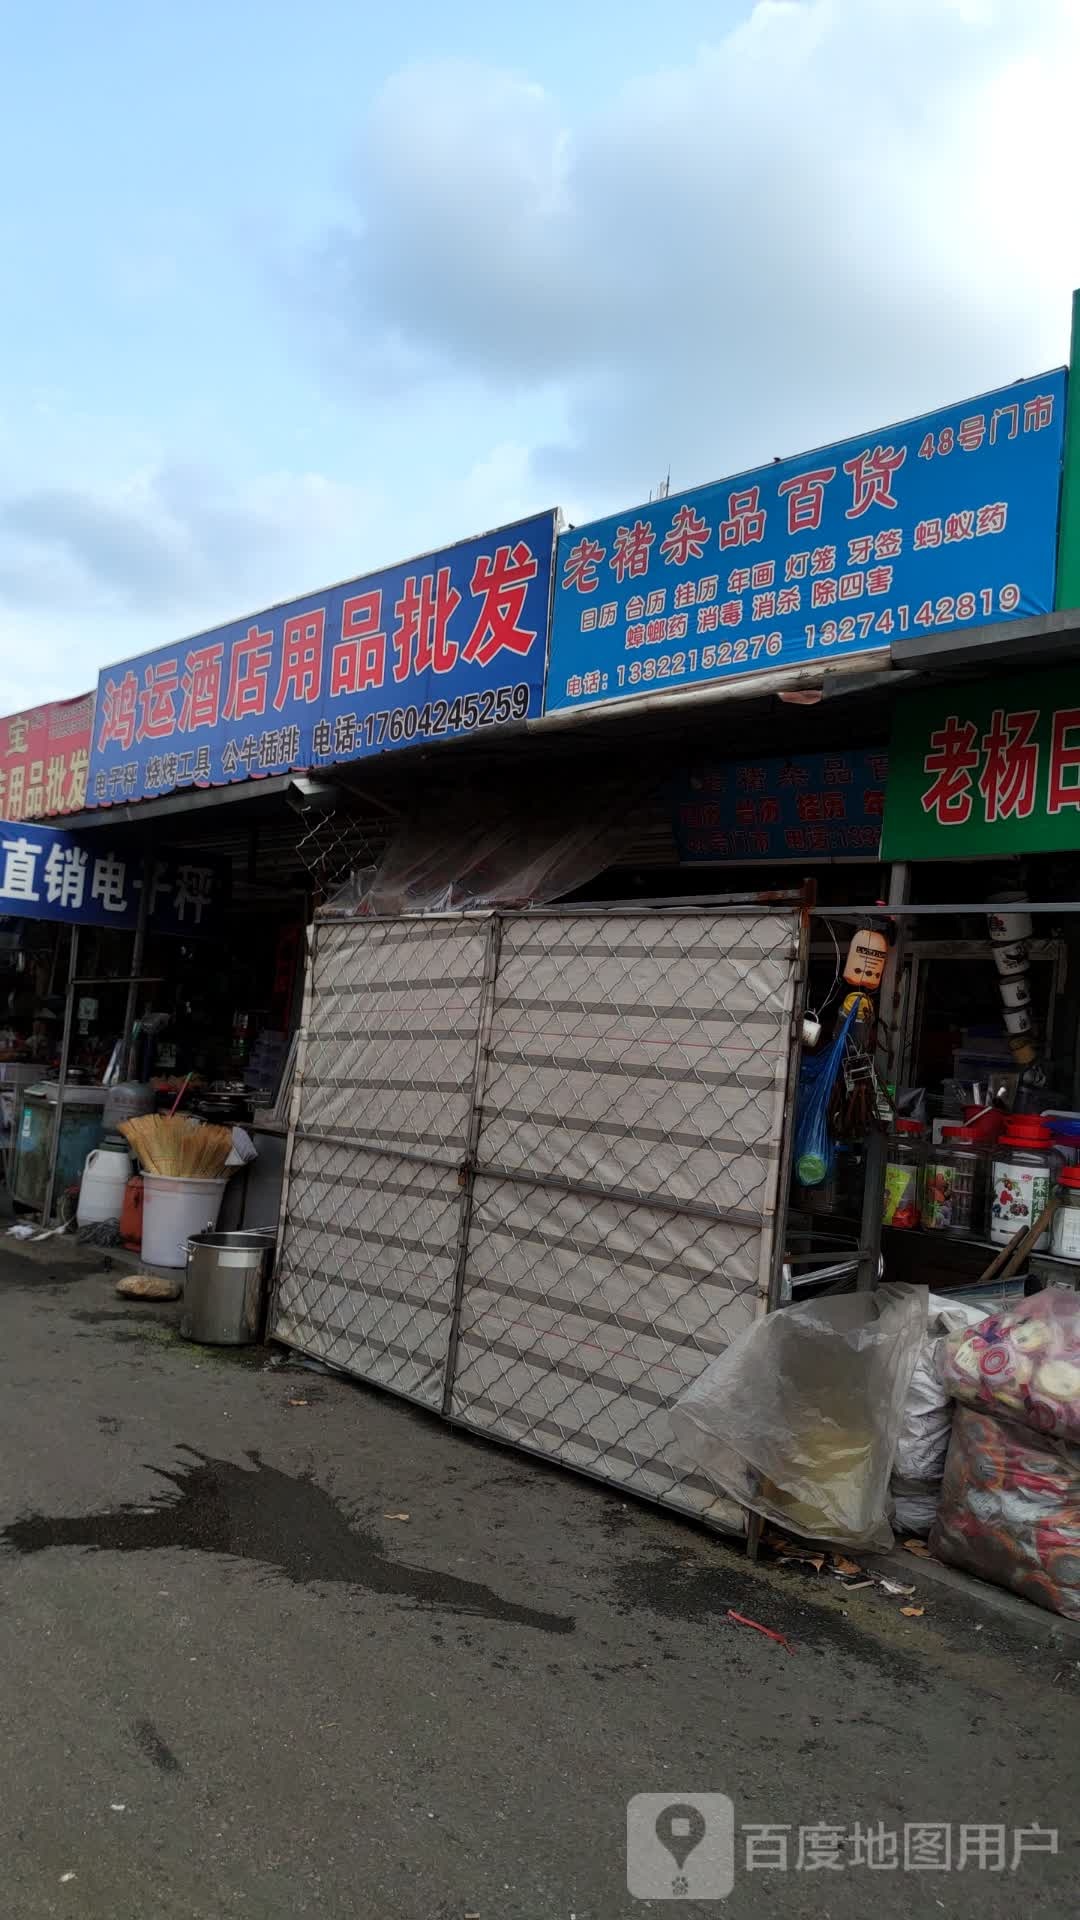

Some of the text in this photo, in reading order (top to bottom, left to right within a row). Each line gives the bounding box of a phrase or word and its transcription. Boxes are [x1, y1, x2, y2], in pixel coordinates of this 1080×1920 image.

[918, 394, 1055, 461] 48号门市
[561, 445, 908, 594] 老褚杂品百货
[580, 502, 1008, 632] 日历 台历 挂历 年画 灯笼 牙签 蚂蚁药
[624, 565, 893, 650] 蟑螂药 消毒 消杀 除四害
[99, 540, 538, 753] 鸿运酒店用品批发
[805, 583, 1021, 649] 13274142819
[94, 761, 138, 799] 电子秤
[143, 746, 212, 789] 烧烤工具
[222, 724, 301, 774] 公牛插排
